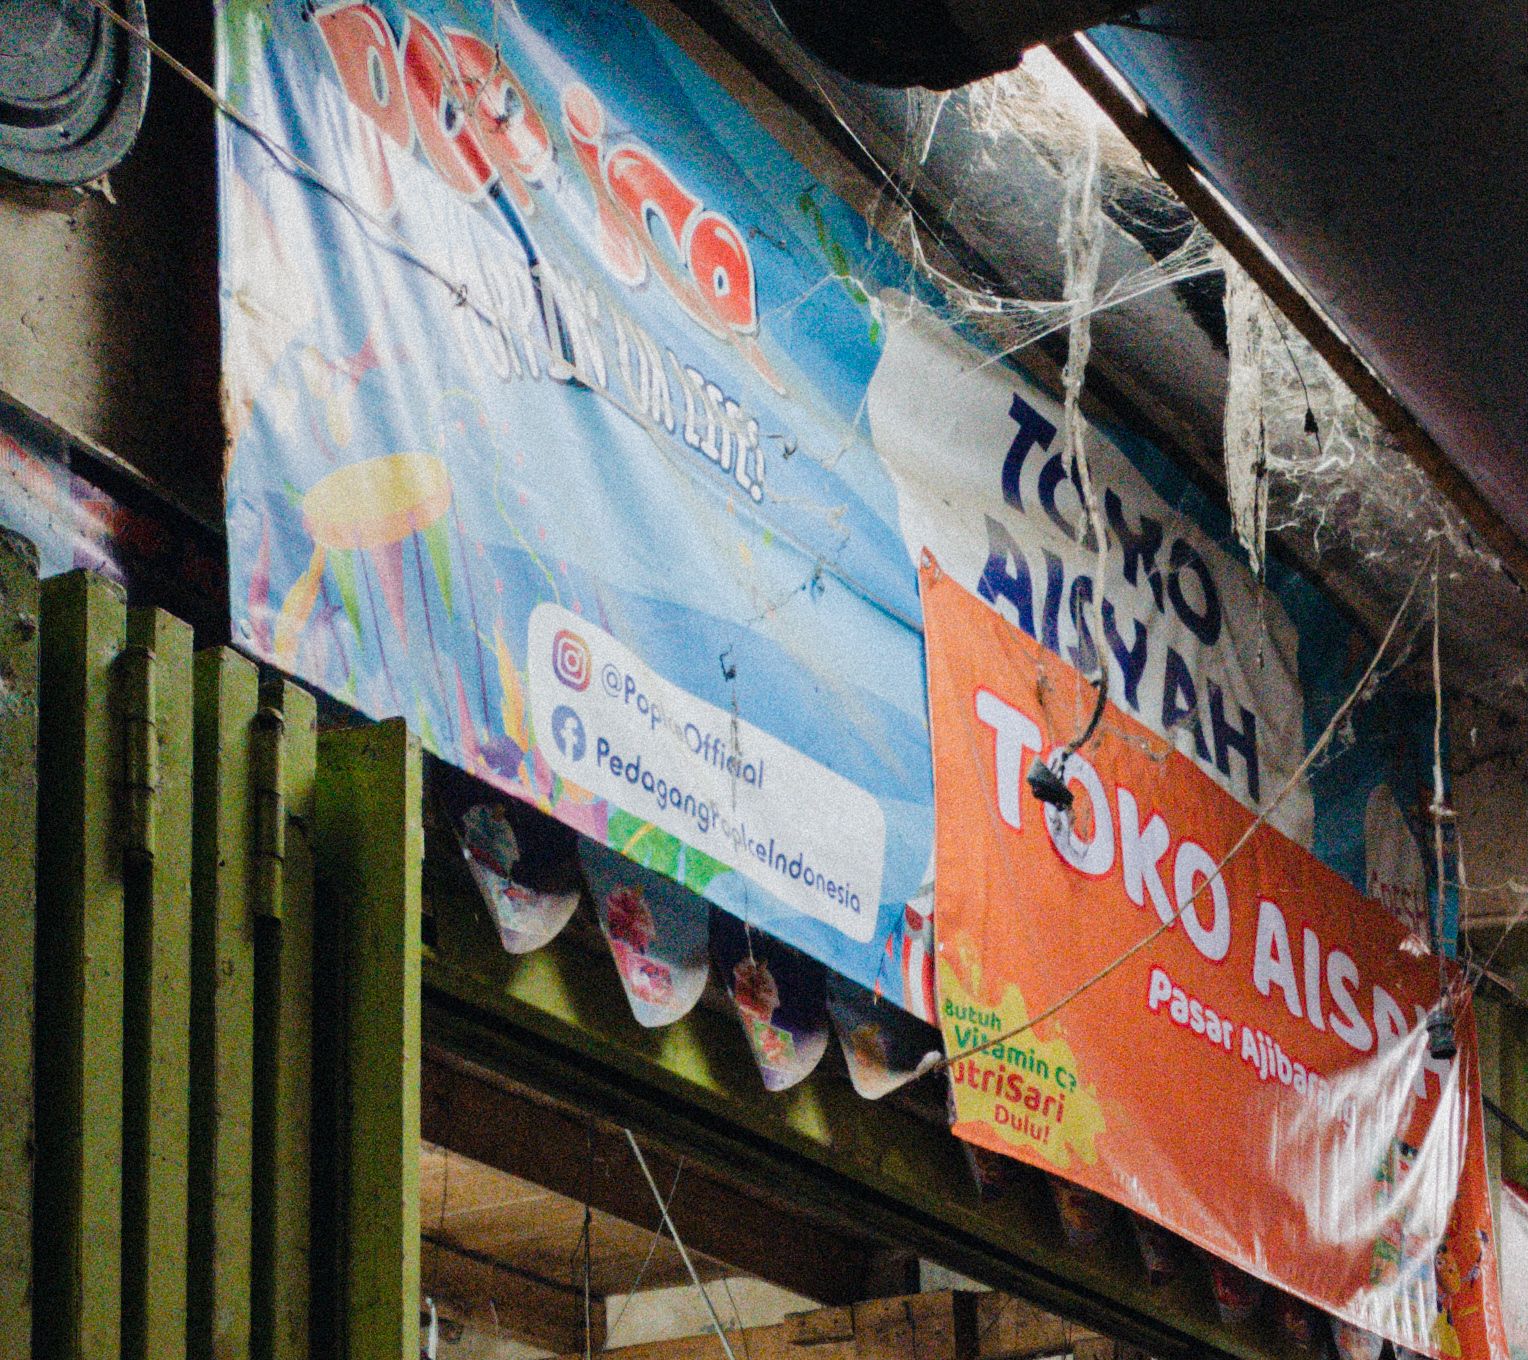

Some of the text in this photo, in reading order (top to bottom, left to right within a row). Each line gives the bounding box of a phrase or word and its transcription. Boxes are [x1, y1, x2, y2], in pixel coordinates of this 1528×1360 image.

[1008, 392, 1222, 647] TOKO
[977, 514, 1260, 803] AISYAH
[975, 687, 1231, 963] TOKO
[944, 997, 1002, 1032] Butuh
[949, 1057, 1067, 1123] utriSari
[954, 1024, 1078, 1094] Vitamin C?
[1241, 1026, 1355, 1130] Ajibarag
[993, 1103, 1052, 1145] Dulu!
